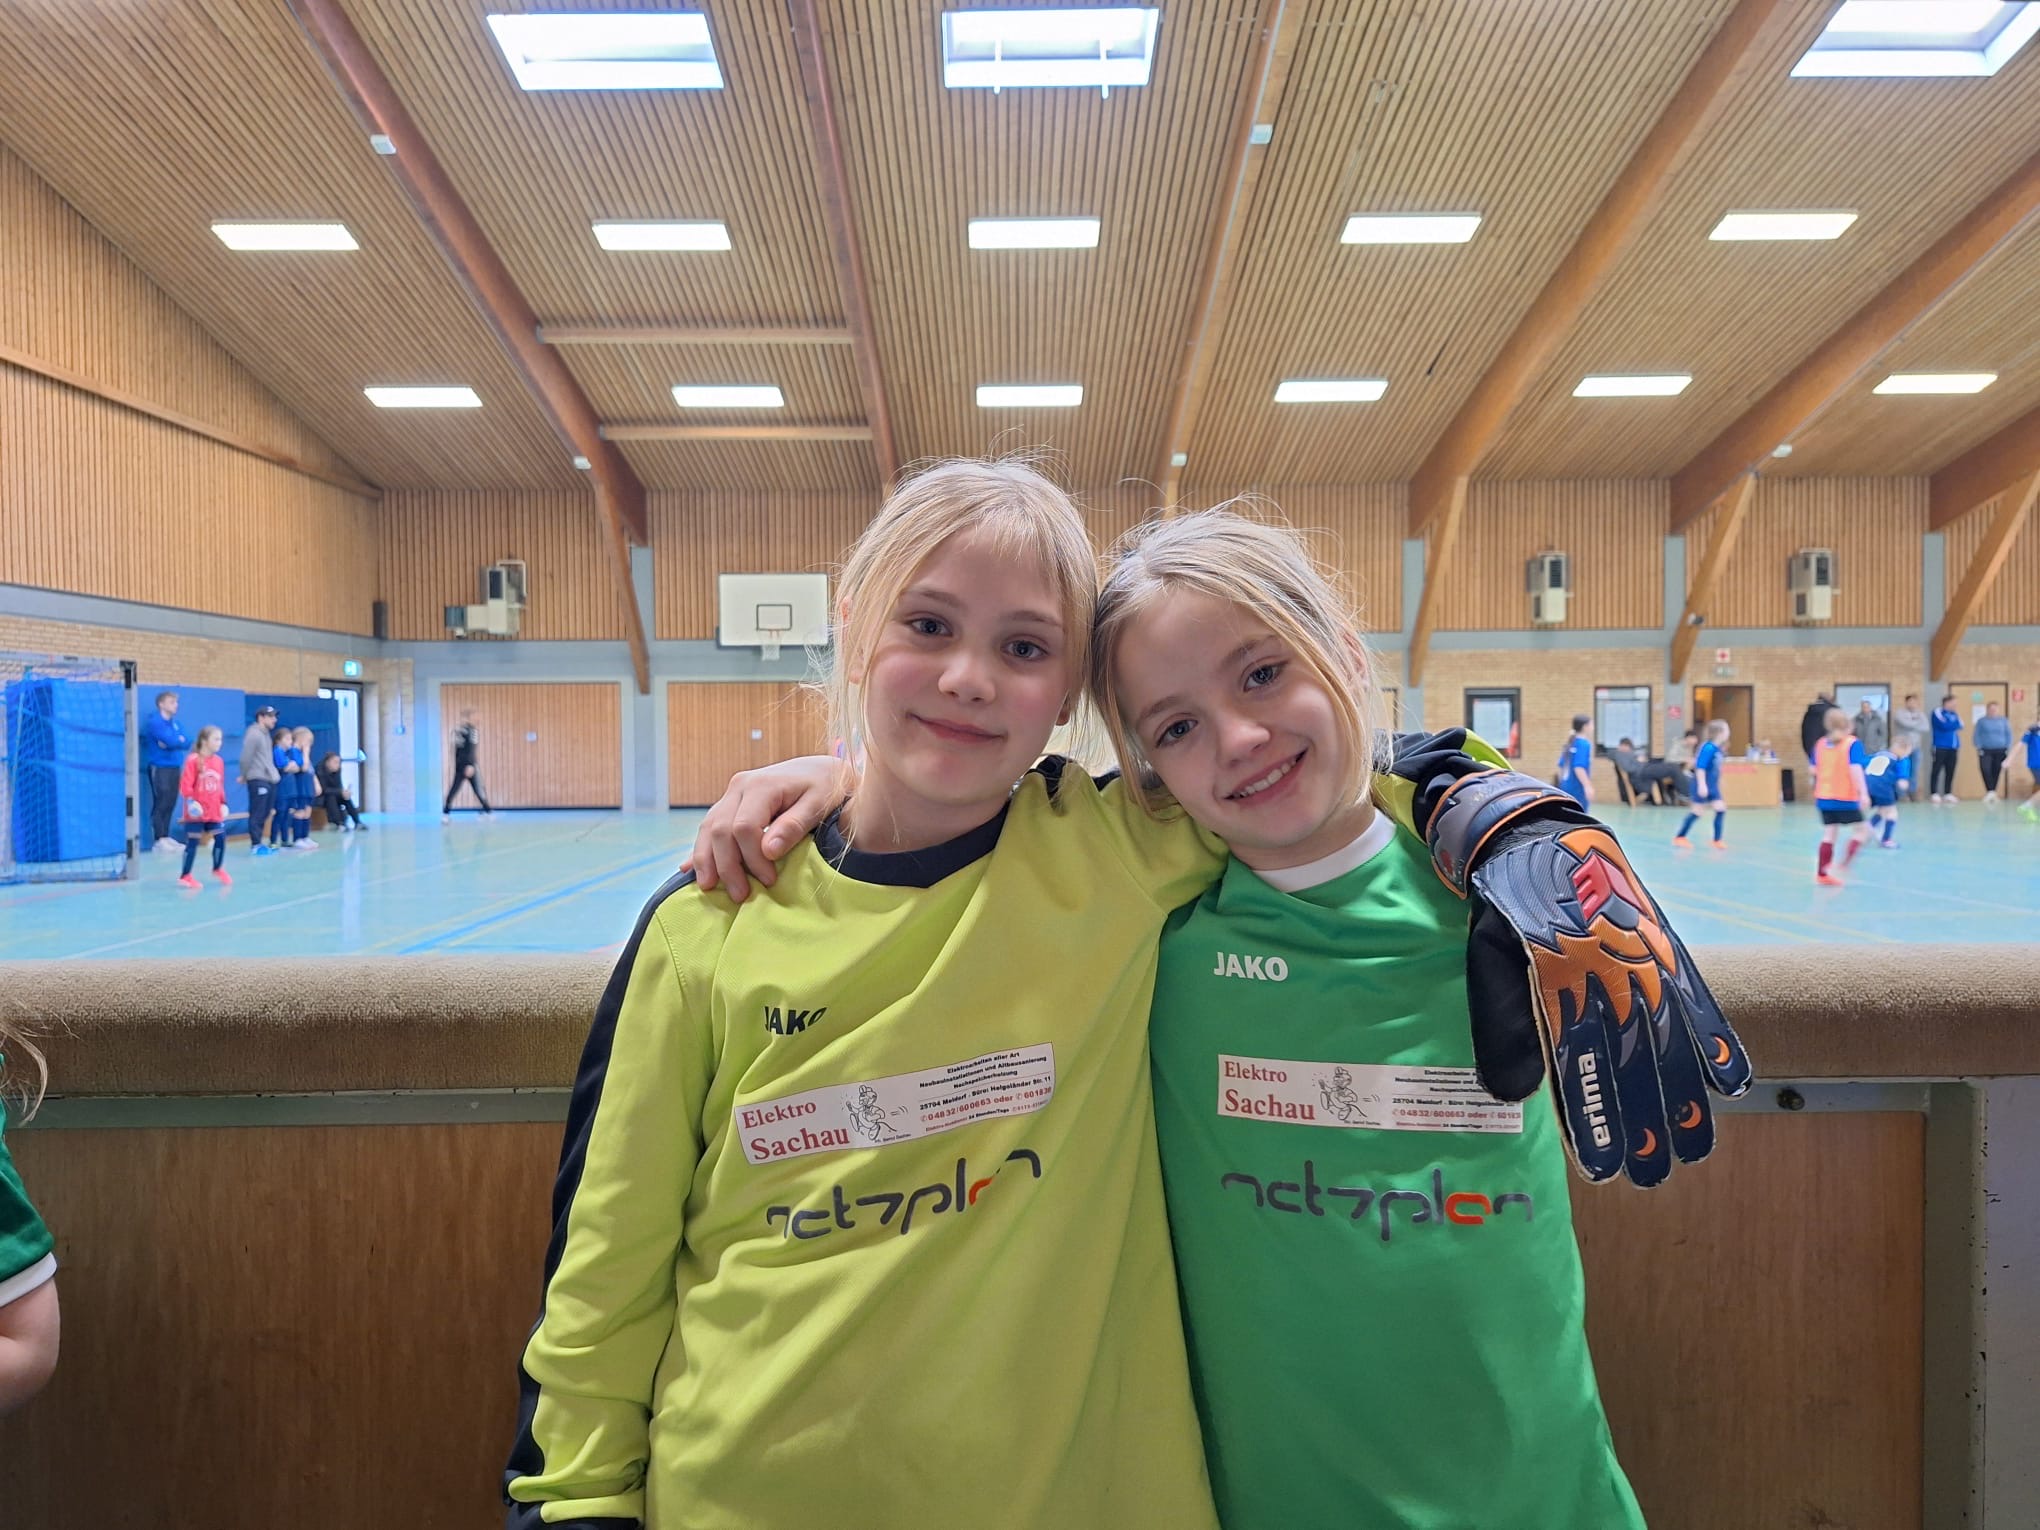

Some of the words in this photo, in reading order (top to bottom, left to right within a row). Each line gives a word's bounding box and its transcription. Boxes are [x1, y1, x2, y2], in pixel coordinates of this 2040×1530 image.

[1213, 951, 1288, 982] JAKO
[984, 1064, 997, 1072] und
[1224, 1060, 1287, 1083] Elektro
[993, 1094, 1014, 1104] oder
[1224, 1088, 1316, 1120] Sachau
[1577, 1051, 1612, 1148] erima
[741, 1101, 817, 1129] Elektro
[1467, 1111, 1488, 1119] oder
[750, 1126, 850, 1160] Sachau
